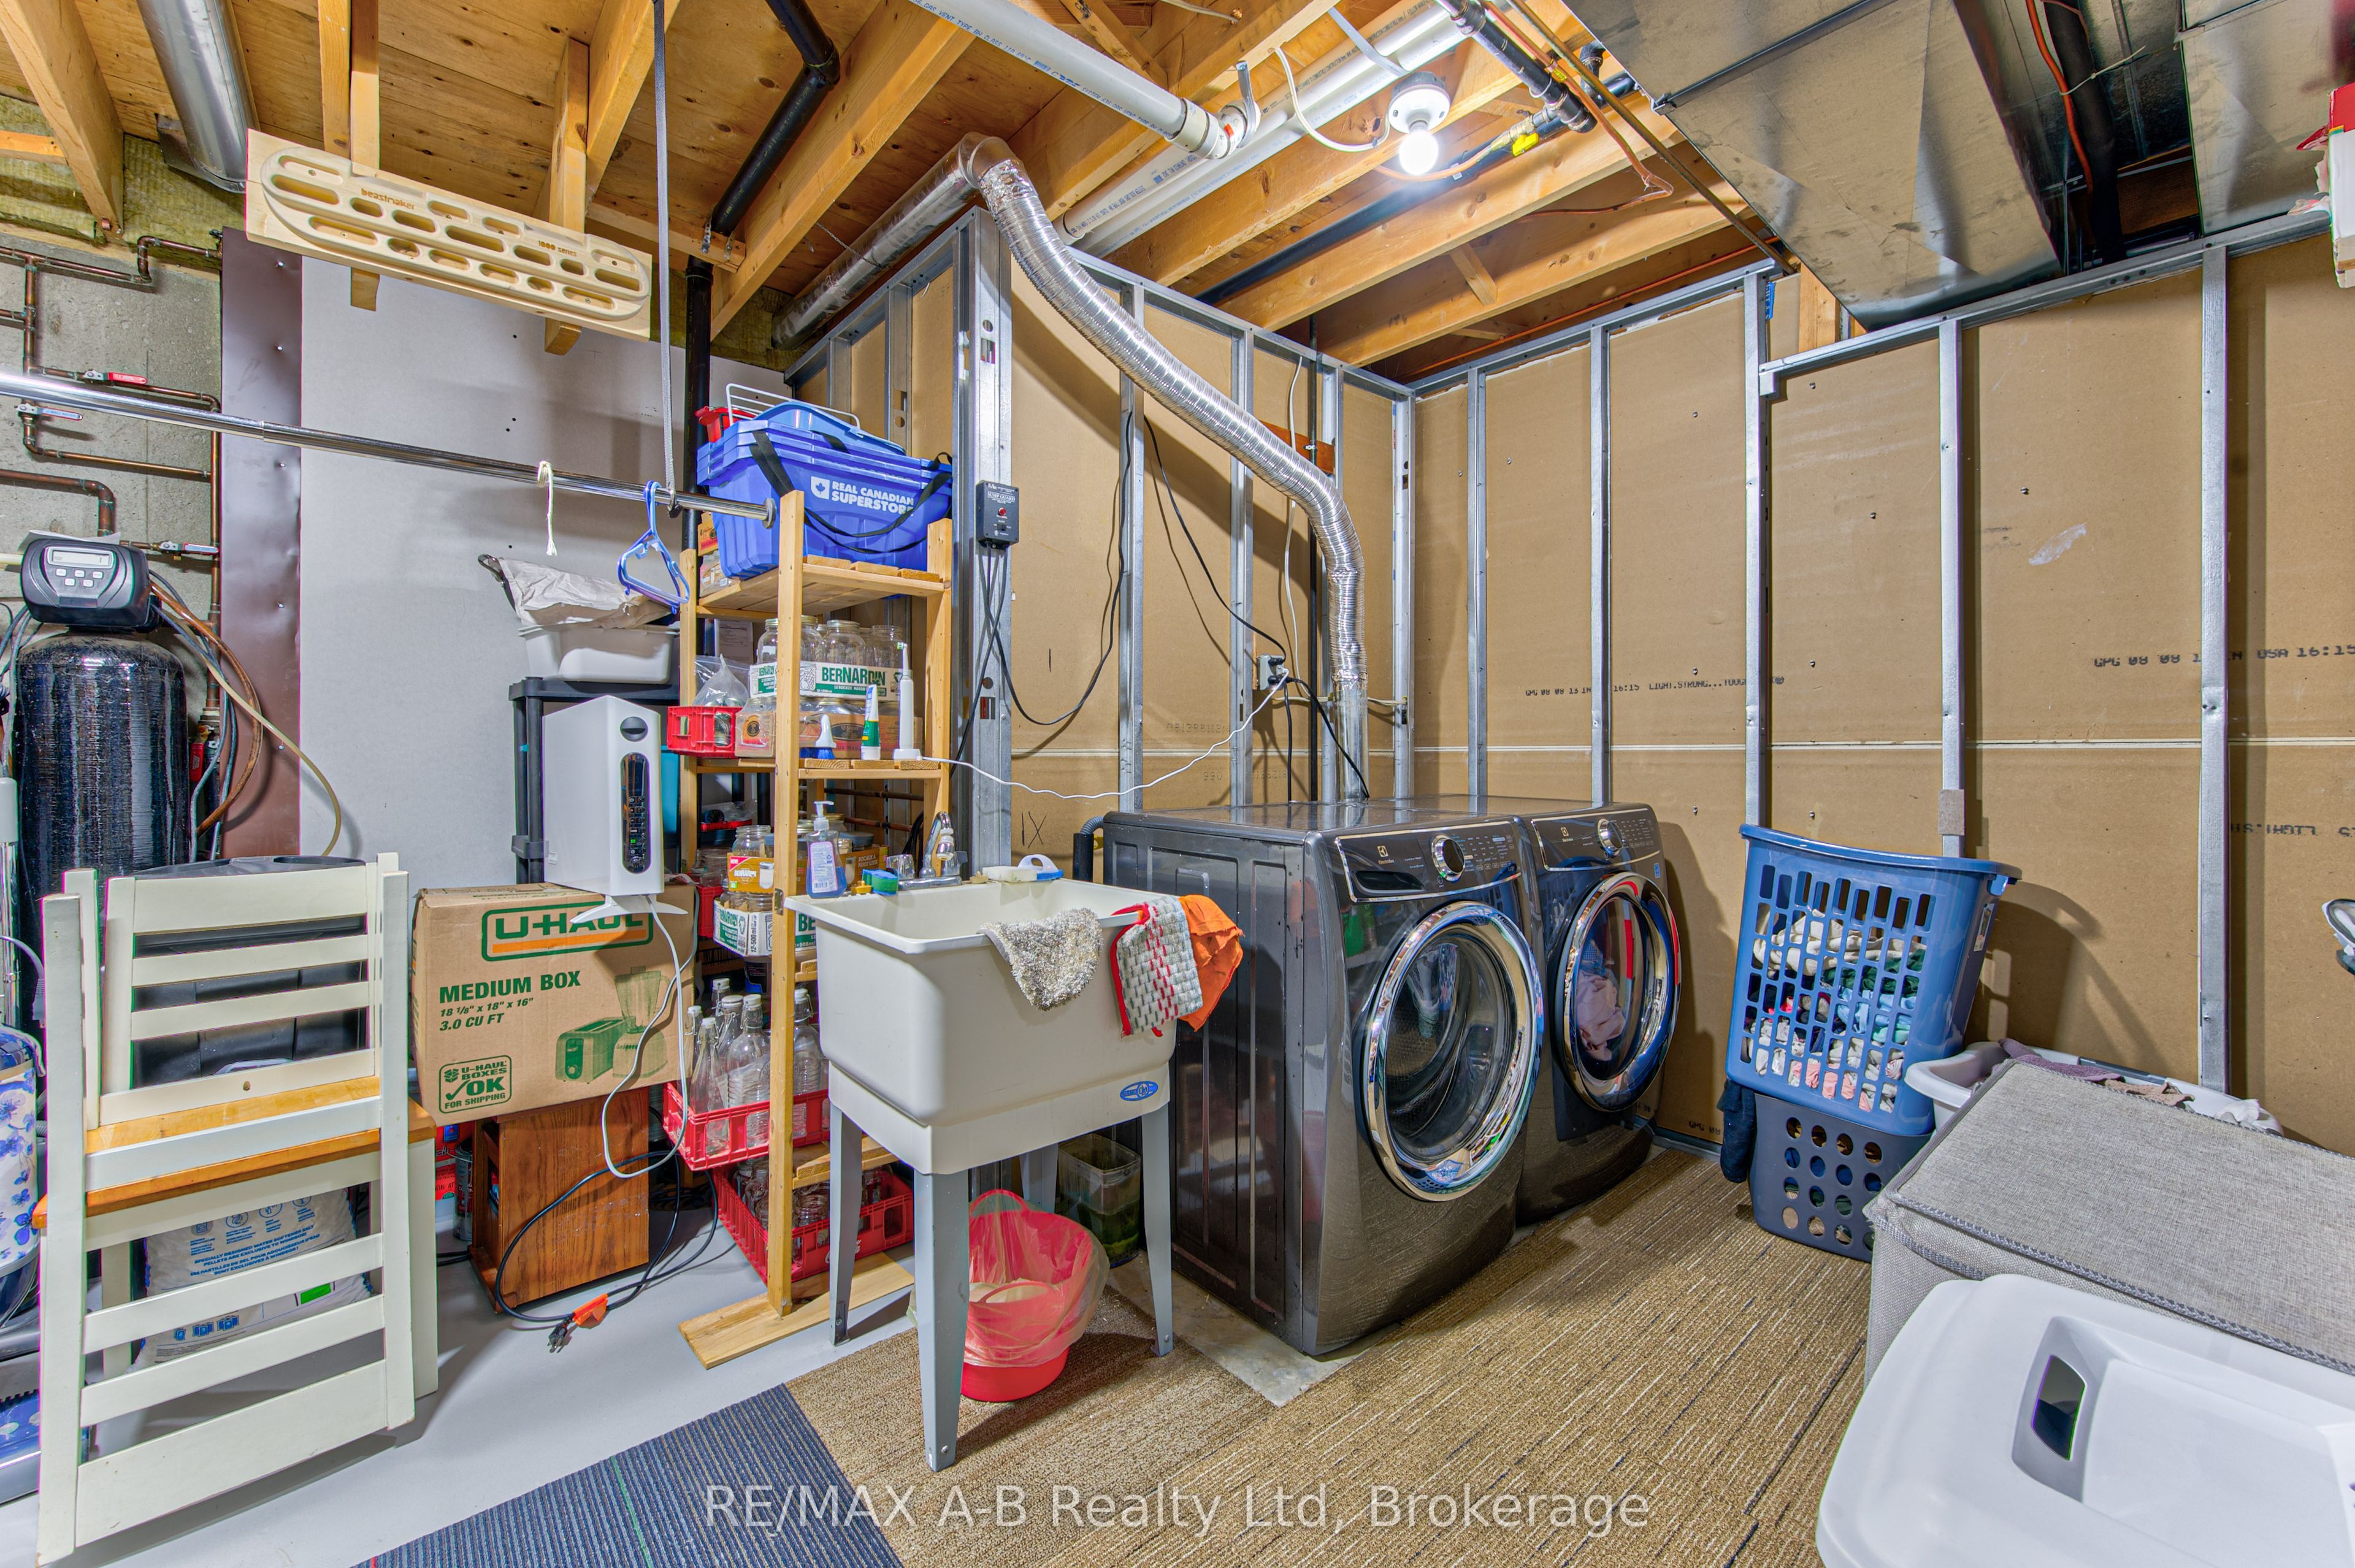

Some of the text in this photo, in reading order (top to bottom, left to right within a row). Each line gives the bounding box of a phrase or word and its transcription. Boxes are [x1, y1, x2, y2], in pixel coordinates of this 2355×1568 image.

[924, 2, 936, 12] GAS
[939, 10, 955, 21] VENT
[957, 20, 972, 30] TYPE
[984, 35, 1002, 47] CLASS
[361, 188, 415, 210] beastmaker
[538, 240, 578, 258] 1000 series
[832, 481, 914, 505] REAL CANADIAN
[822, 667, 886, 686] BERNARDIN
[496, 912, 643, 939] U-HAUL
[440, 970, 581, 1004] MEDIUM BOX
[440, 1008, 453, 1017] 18
[487, 1001, 504, 1011] 18"
[517, 997, 534, 1007] 16"
[440, 1012, 505, 1031] 3.0 CU FT
[461, 1061, 507, 1074] U-HAUL
[461, 1068, 507, 1080] BOXES
[466, 1076, 505, 1096] OK
[445, 1093, 505, 1109] FOR SHIPPING
[194, 1253, 223, 1264] SPECIALLY
[224, 1245, 253, 1256] DESIGNED
[253, 1239, 273, 1248] WATER
[274, 1230, 301, 1242] SOFTENER
[201, 1263, 230, 1274] PASTILLES
[267, 1239, 305, 1255] ADOUCISSEUR
[305, 1233, 320, 1242] D'EAU
[204, 1257, 228, 1266] PELLETS
[240, 1245, 272, 1257] EXCLUSIVE
[230, 1258, 265, 1271] EXCLUSIVES
